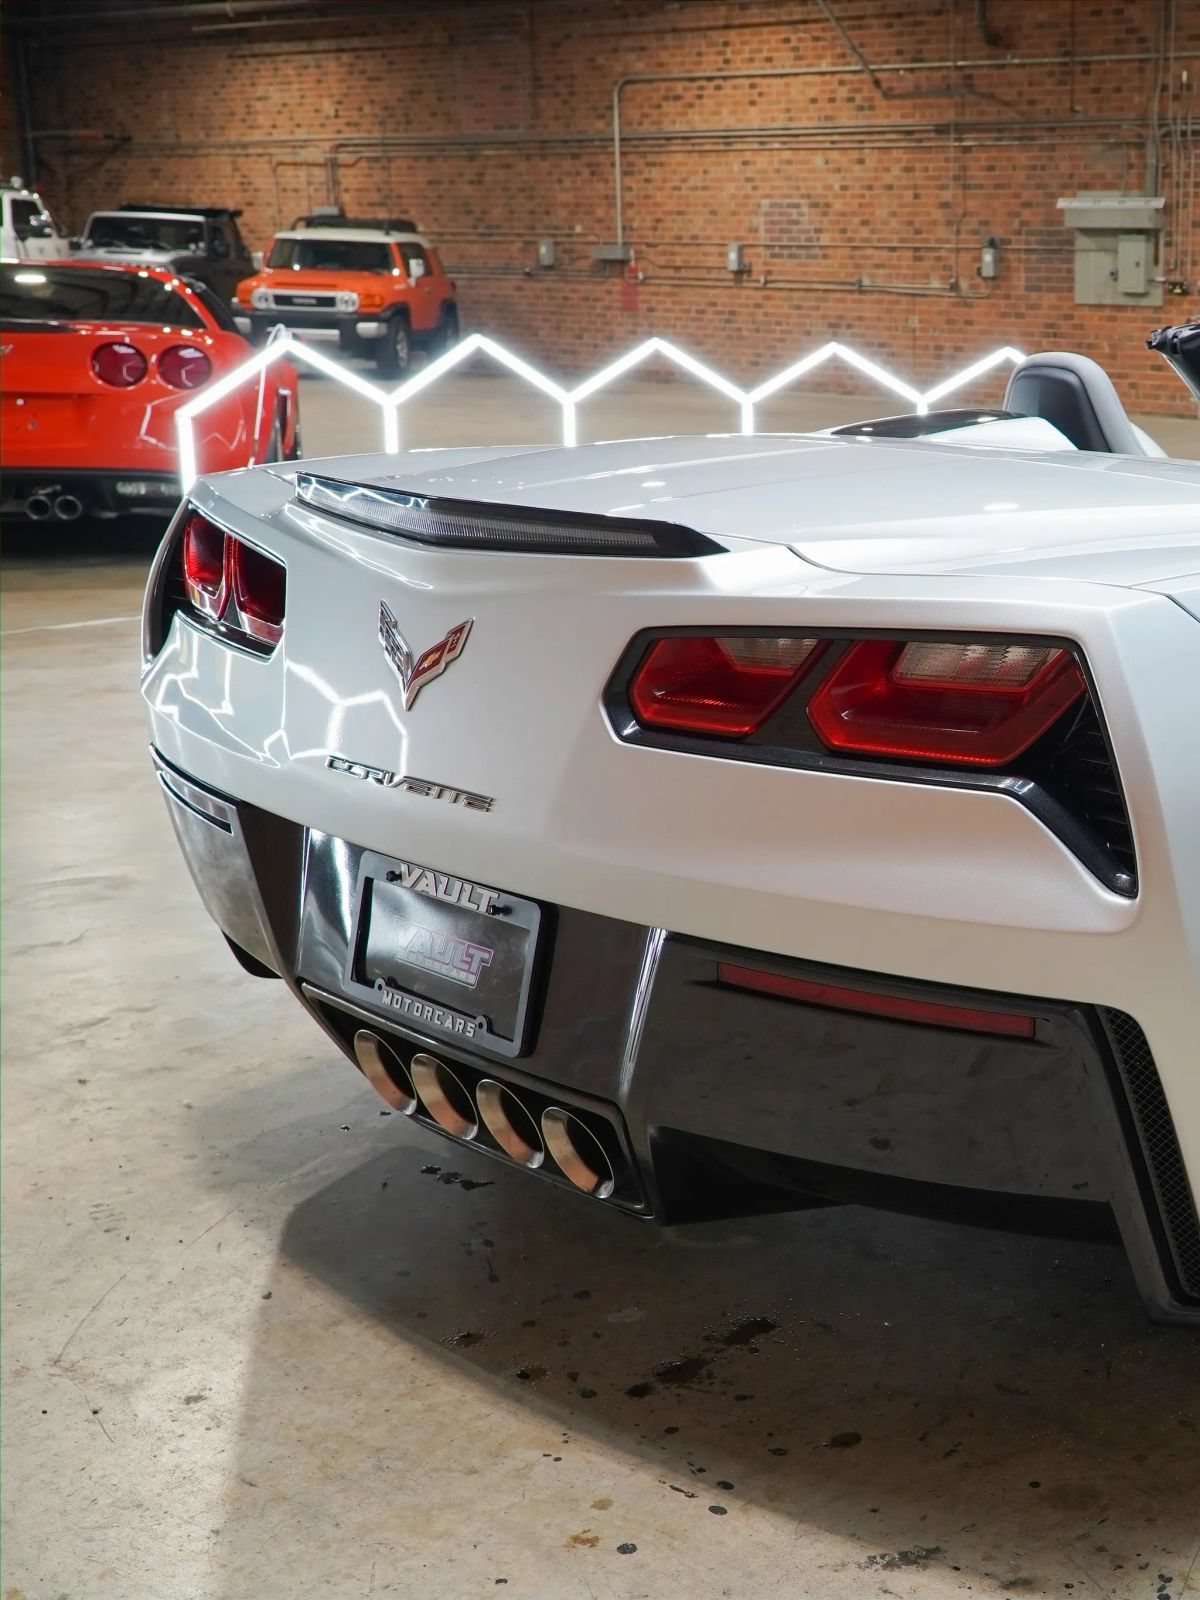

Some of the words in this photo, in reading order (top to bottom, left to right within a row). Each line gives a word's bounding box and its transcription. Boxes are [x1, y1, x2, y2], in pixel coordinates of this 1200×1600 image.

[325, 755, 496, 813] CORVETTE
[400, 863, 500, 914] VAULT
[381, 989, 477, 1039] MOTORCARS
